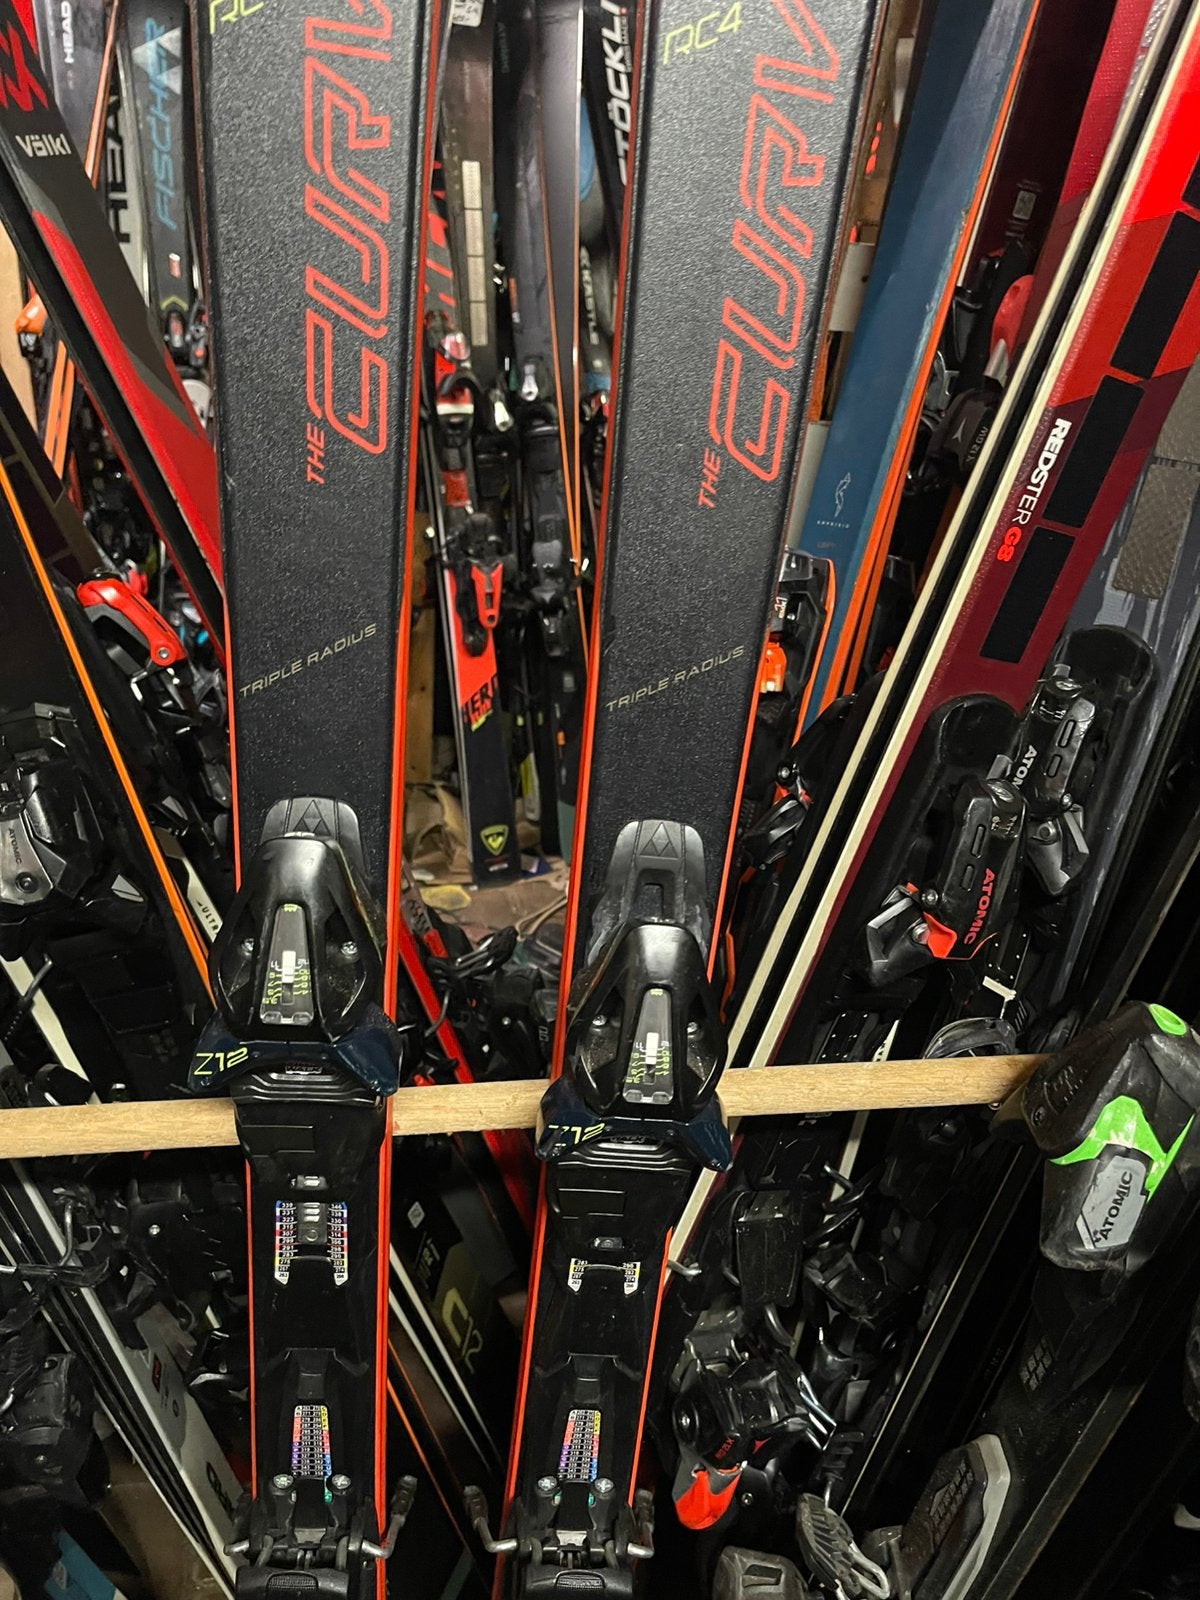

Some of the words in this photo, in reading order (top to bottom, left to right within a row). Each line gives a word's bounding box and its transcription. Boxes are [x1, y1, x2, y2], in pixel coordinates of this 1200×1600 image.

[61, 1, 74, 63] HEAD
[663, 1, 742, 65] RC4
[145, 17, 178, 230] FISCHER
[600, 0, 632, 187] TÖCKLI
[15, 133, 72, 158] Völkl
[106, 93, 131, 244] HEA
[306, 423, 325, 485] THE
[698, 448, 723, 508] THE
[1012, 418, 1072, 525] REDSTER
[240, 659, 304, 698] TRIPLE
[307, 623, 377, 667] RADIUS
[605, 677, 670, 712] TRIPLE
[669, 645, 744, 684] RADIUS
[9, 827, 22, 865] ATOMIC
[964, 867, 995, 945] ATOMIC
[194, 1047, 249, 1075] Z12
[1099, 1171, 1133, 1241] ATOMIC
